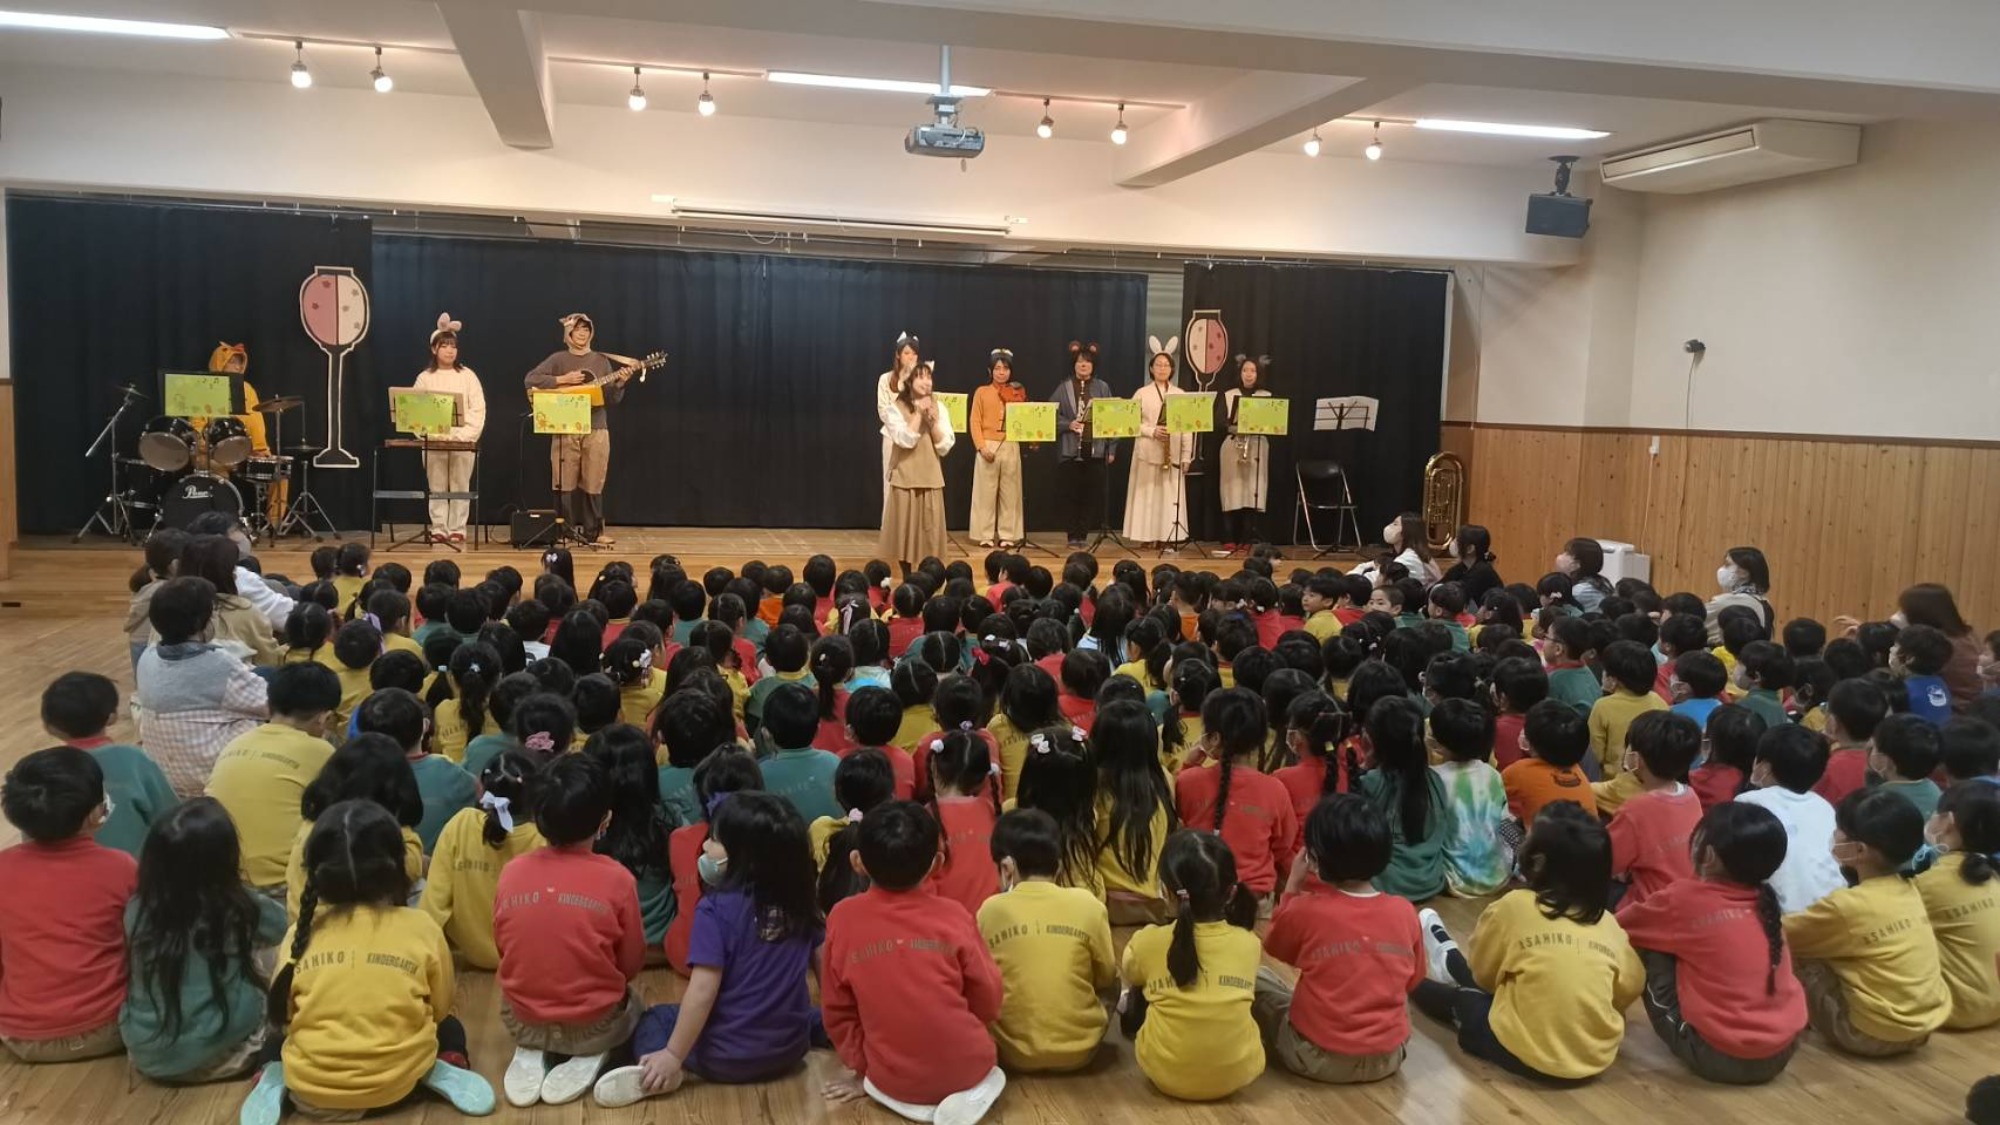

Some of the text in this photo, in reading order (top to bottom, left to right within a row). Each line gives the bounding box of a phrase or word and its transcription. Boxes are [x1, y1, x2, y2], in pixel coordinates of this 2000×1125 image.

[988, 924, 1028, 949] SAHIKO
[1518, 932, 1572, 950] ASAHIKO
[1863, 918, 1912, 945] ASAHIKO
[295, 951, 345, 976] SAHIKO
